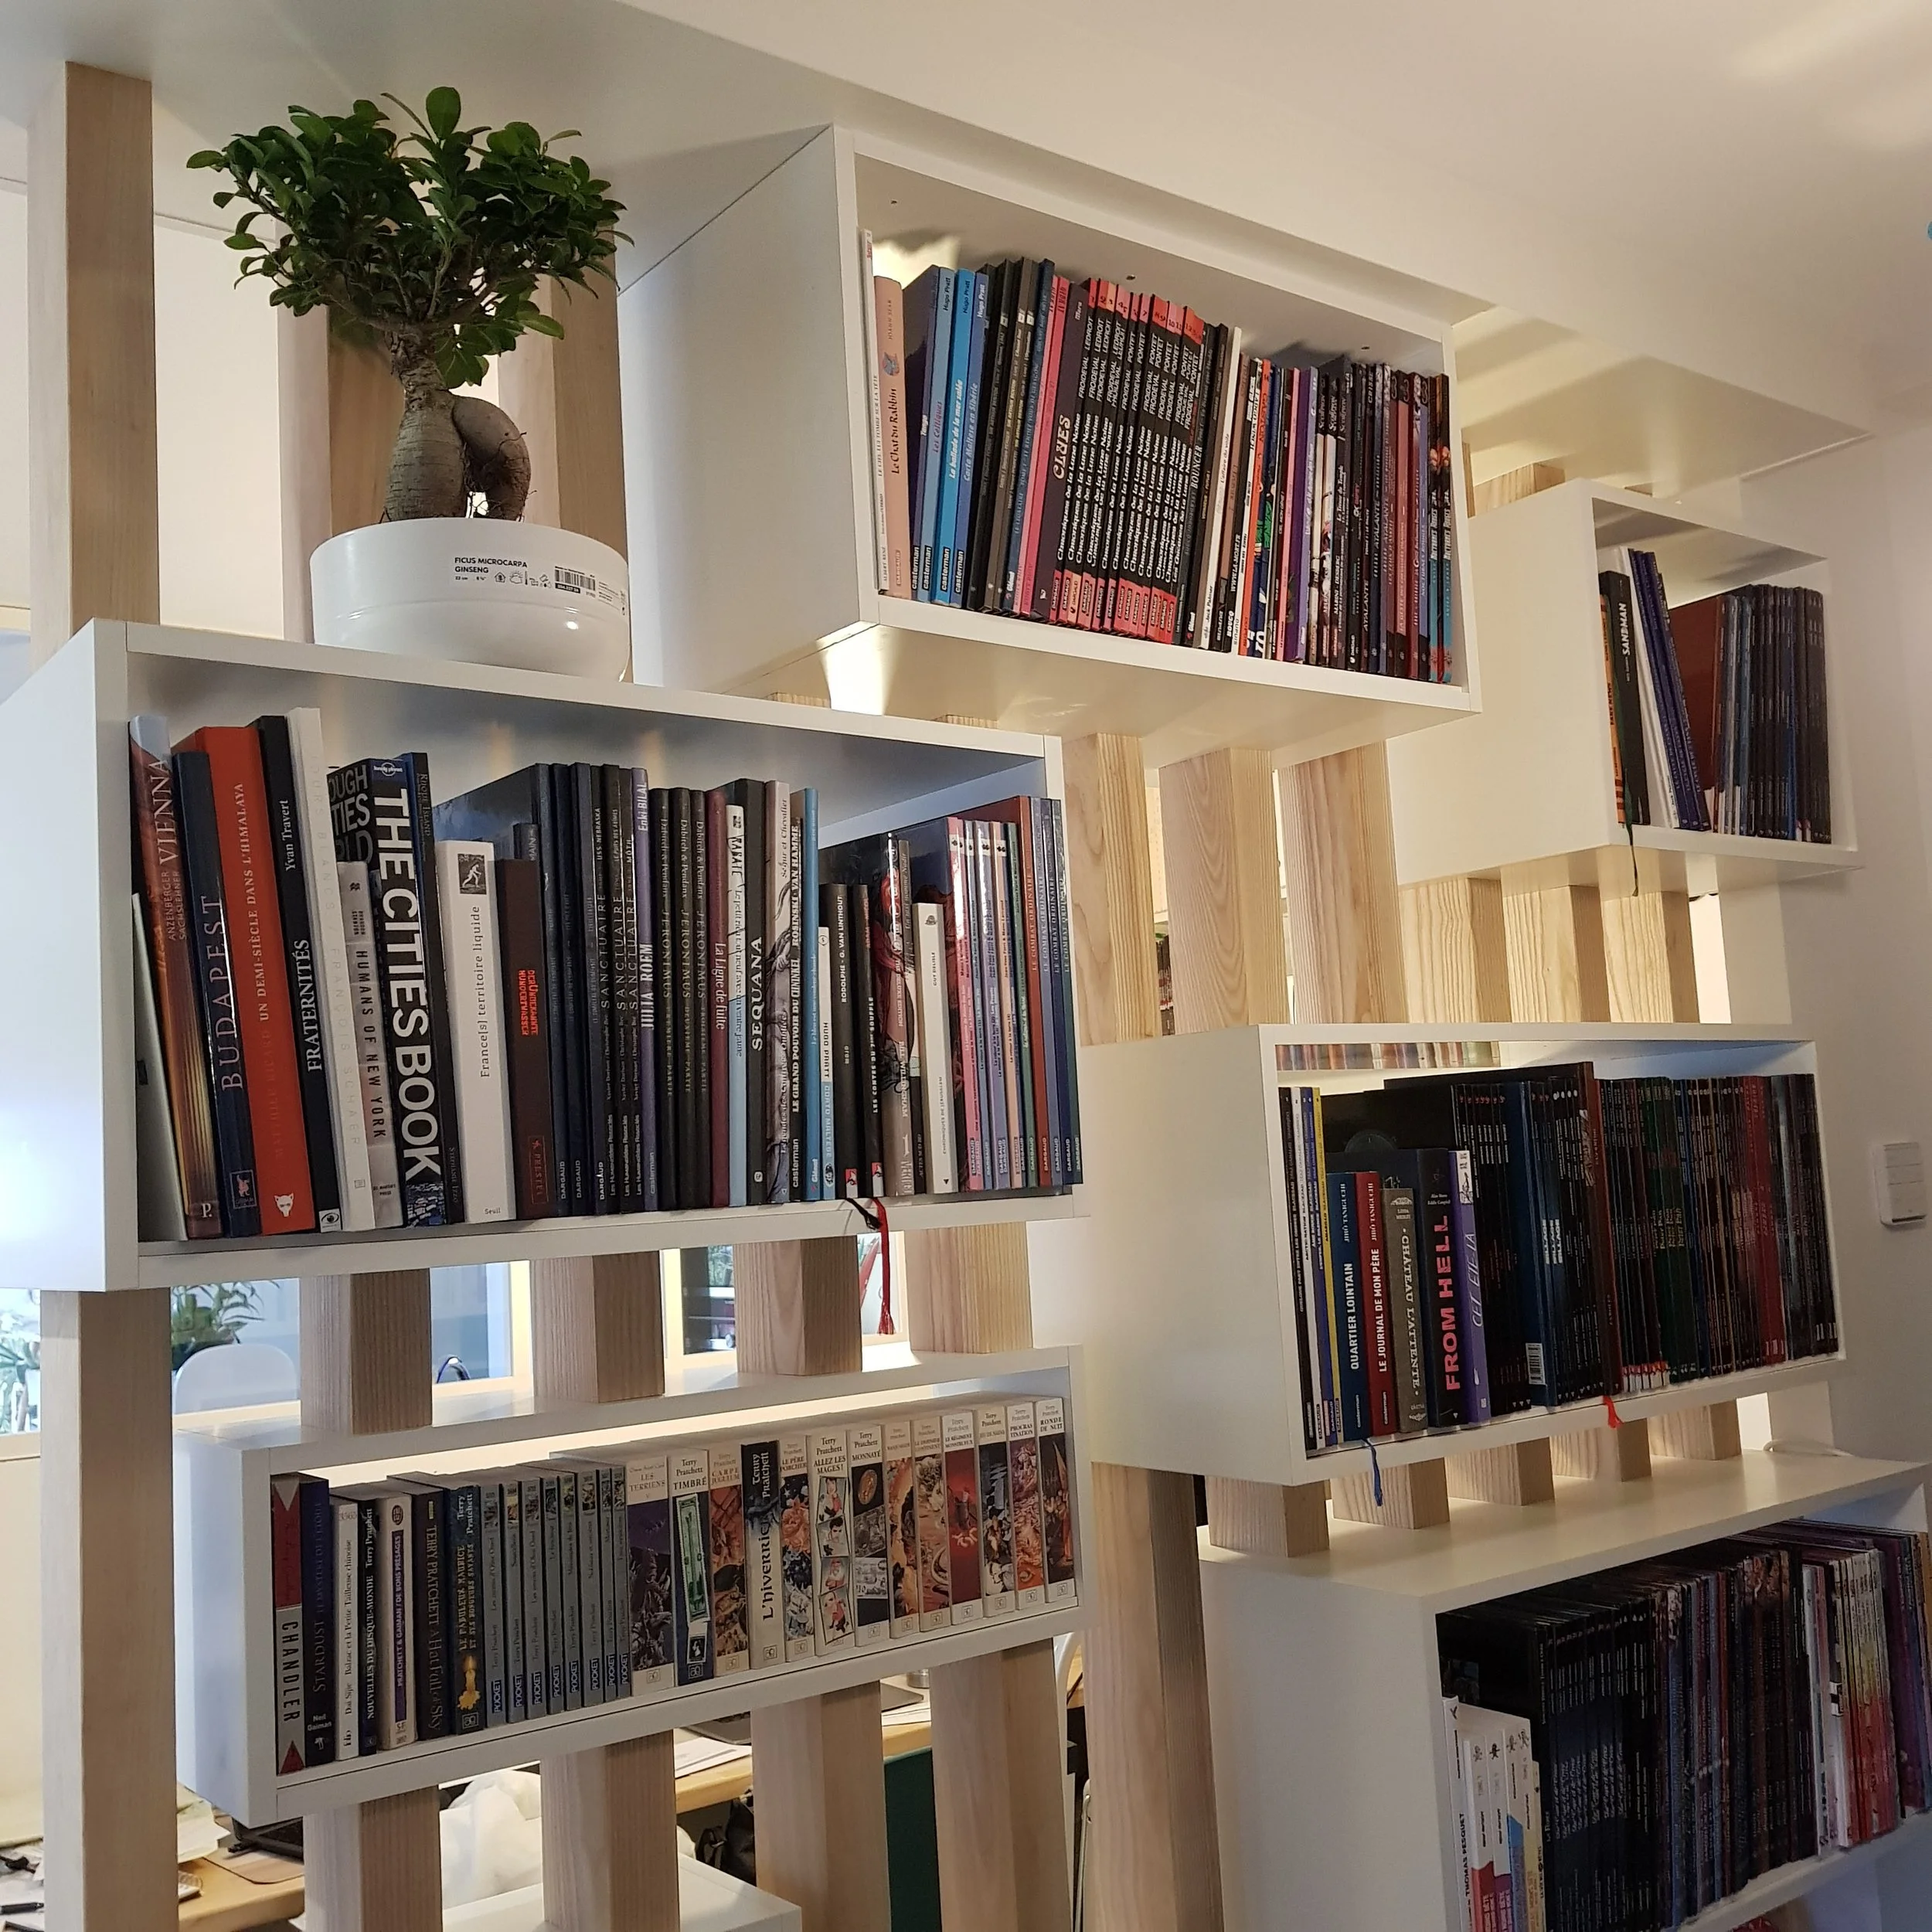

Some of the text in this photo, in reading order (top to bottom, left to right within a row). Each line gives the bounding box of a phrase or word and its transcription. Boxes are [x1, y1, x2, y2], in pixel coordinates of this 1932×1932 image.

[1121, 331, 1136, 411] FROIDEVAL PONTET
[1131, 332, 1145, 412] FROIDEVAL PONTET
[888, 388, 899, 424] Rabbin
[890, 442, 900, 461] Chat
[952, 426, 959, 437] de
[892, 462, 900, 474] Le
[949, 468, 956, 478] La
[950, 438, 958, 468] ballade
[1191, 445, 1203, 488] BOUNCER
[1120, 495, 1125, 509] de
[1121, 483, 1127, 495] la
[1112, 511, 1124, 570] Chroniques
[478, 558, 528, 568] MICROCARPA
[1618, 603, 1631, 655] SANDMAN
[149, 759, 180, 866] VIENNA
[637, 781, 648, 832] Enki BILAL
[791, 825, 800, 868] HAMME
[160, 870, 177, 940] ANZENBERGER
[233, 782, 269, 1022] UN DEMI-SIÈCLE DANS L'HIMALAYA
[1026, 874, 1035, 921] ORDINAIRE
[1049, 877, 1058, 923] ORDINAIRE
[278, 799, 322, 1073] FRATERNITÉS Yvan Travert
[791, 895, 800, 947] ROSINSKI
[613, 895, 627, 1011] SANCTUAIRE
[626, 896, 639, 1011] SANCTUAIRE
[696, 910, 706, 999] JERONIMUS
[1032, 963, 1037, 971] LE
[1054, 964, 1060, 973] LE
[201, 895, 243, 1091] BUDAPEST
[373, 787, 442, 1182] THE CITIES BOOK
[469, 906, 491, 1078] France[s] territoire liquide
[639, 943, 655, 1030] JULIA ROEM
[710, 942, 728, 1030] La Ligne de fuite
[750, 937, 764, 1052] SEQUANA
[792, 999, 799, 1015] DU
[355, 950, 386, 1138] HUMANS OF NEW YORK
[870, 1051, 876, 1062] DU
[792, 1097, 799, 1114] LE
[484, 1207, 501, 1216] Seuil
[1340, 1182, 1349, 1224] TANIGUCHI
[1367, 1182, 1376, 1223] TANIGUCHI
[1344, 1263, 1359, 1370] QUARTIER LOINTAIN
[1369, 1248, 1387, 1372] LE JOURNAL DE MON PÈRE
[1401, 1235, 1420, 1389] CHÂTEAU L'ATTENTE
[1434, 1215, 1460, 1389] FROM HELL
[821, 1437, 836, 1447] Terry
[859, 1431, 872, 1440] Terry
[1050, 1422, 1063, 1432] NUIT
[790, 1454, 804, 1464] PÈRE
[814, 1455, 846, 1468] ALLEZ LES
[816, 1444, 842, 1456] Pratchett
[852, 1450, 881, 1461] MONNAYÉ
[628, 1479, 665, 1492] TERRIENS
[640, 1472, 654, 1481] LES
[673, 1476, 707, 1491] TIMBRÉ
[366, 1546, 374, 1569] Terry
[425, 1525, 439, 1558] TERRY
[366, 1575, 375, 1648] DISQUE-MONDE
[395, 1592, 403, 1604] DE
[425, 1561, 440, 1626] PRATCHETT
[344, 1631, 351, 1640] la
[395, 1607, 403, 1638] GAIMAN
[281, 1621, 301, 1723] CHANDLER
[313, 1619, 326, 1693] STARDUST
[367, 1648, 375, 1664] DU
[396, 1646, 404, 1687] PRATCHETT
[426, 1638, 442, 1665] Hat
[366, 1665, 375, 1719] NOUVELLES
[427, 1665, 444, 1692] Full
[428, 1704, 444, 1731] Sky
[1459, 1812, 1470, 1896] THOMAS PESQUET
